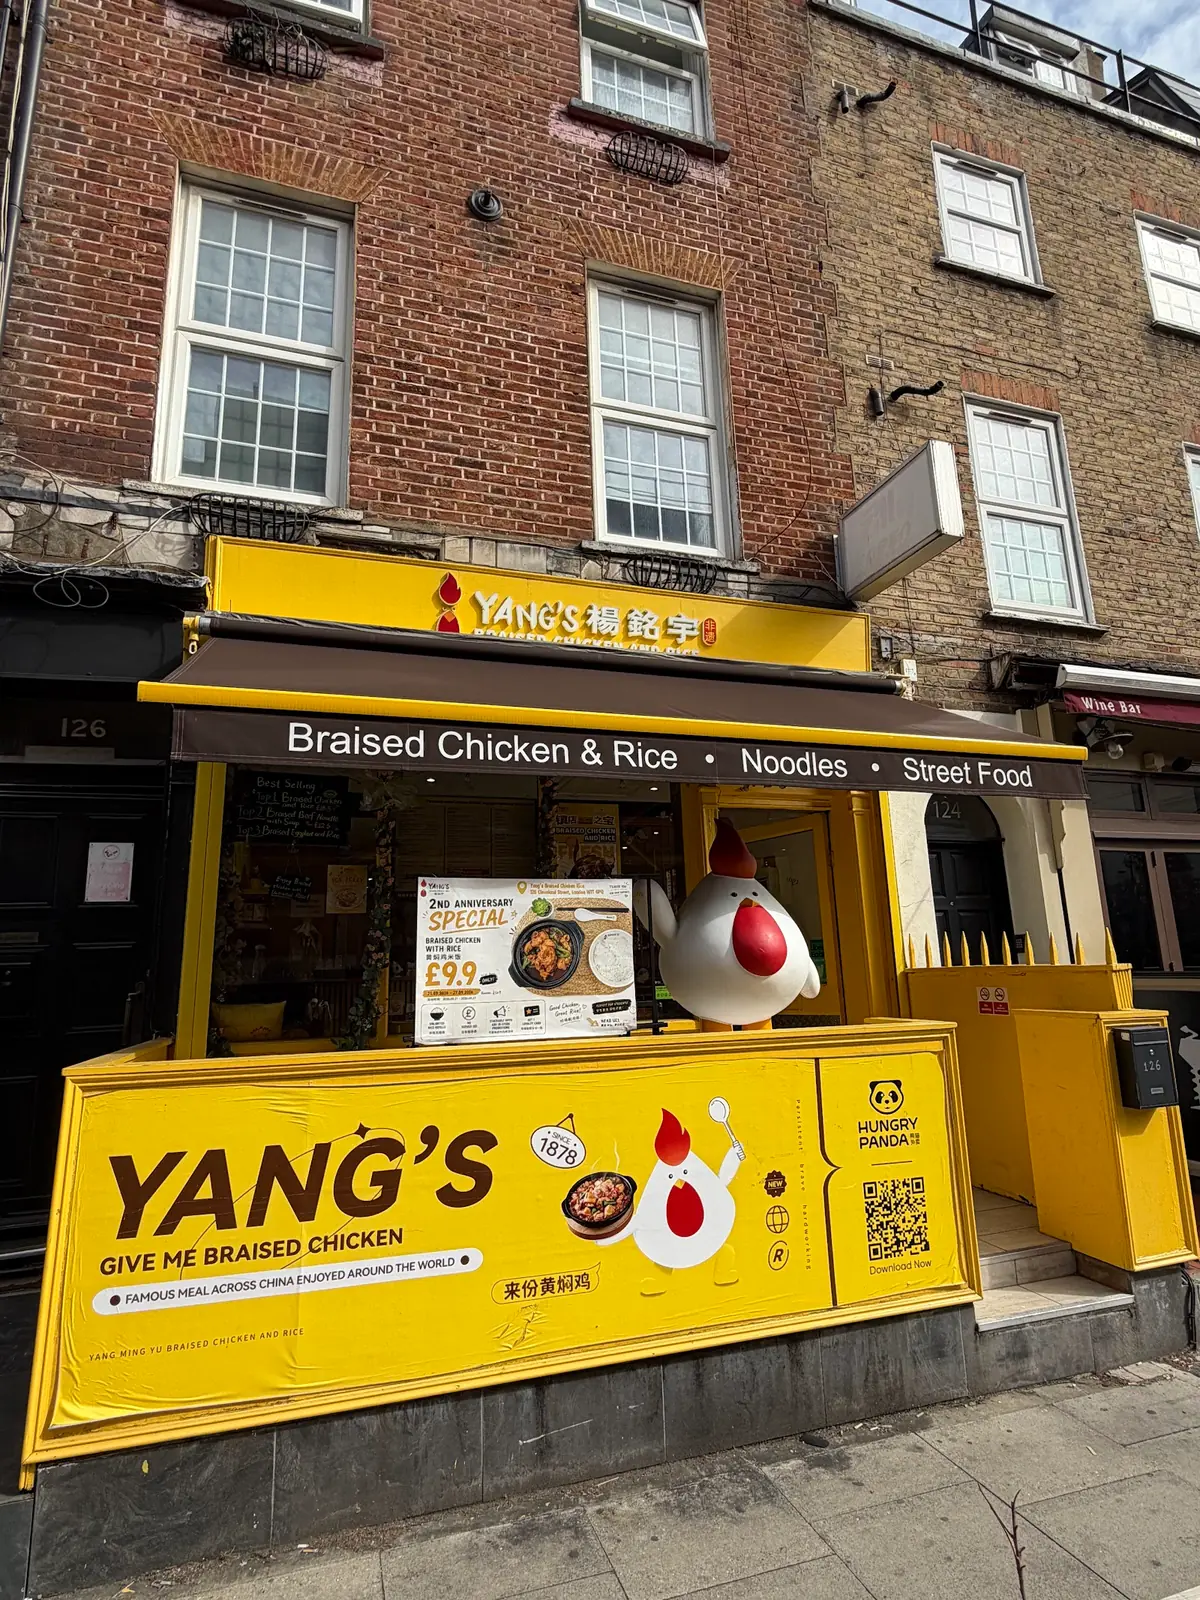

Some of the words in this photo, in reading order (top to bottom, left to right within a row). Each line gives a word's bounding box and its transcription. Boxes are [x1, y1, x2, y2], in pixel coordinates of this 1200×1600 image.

[474, 591, 579, 633] YANG'S
[586, 604, 701, 645] 楊銘宇
[1081, 697, 1115, 713] Wine
[1121, 700, 1142, 715] Bar
[61, 717, 106, 738] 126
[288, 722, 425, 758] Braised
[438, 731, 569, 764] Chicken
[580, 738, 603, 767] &
[614, 741, 678, 770] Rice
[741, 748, 848, 778] Noodles
[903, 757, 972, 785] Street
[978, 762, 1033, 788] Food
[257, 776, 280, 788] Best
[284, 778, 316, 795] Selling
[932, 801, 962, 819] 124
[429, 899, 450, 909] 2ND
[454, 898, 514, 908] ANNIVERSARY
[428, 908, 508, 931] SPECIAL
[425, 961, 477, 986] £9.9
[1143, 1059, 1161, 1072] 126
[858, 1117, 918, 1134] HUNGRY
[552, 1131, 572, 1145] SINCE
[859, 1133, 909, 1149] PANDA
[540, 1138, 578, 1165] 1878
[109, 1125, 499, 1240] YANG'S
[768, 1180, 783, 1188] NEW
[100, 1253, 156, 1276] GIVE
[163, 1249, 197, 1269] ME
[204, 1238, 301, 1265] BRAISED
[308, 1228, 403, 1254] CHICKEN
[869, 1263, 912, 1275] Download
[914, 1259, 932, 1268] Now
[125, 1289, 181, 1305] FAMOUS
[178, 1286, 210, 1299] MEAL
[211, 1280, 257, 1295] ACROSS
[259, 1276, 295, 1290] CHINA
[296, 1270, 346, 1285] ENJOYED
[347, 1264, 394, 1279] AROUND
[396, 1261, 416, 1273] THE
[418, 1257, 455, 1270] WORLD
[504, 1272, 591, 1300] 来份黄焖鸡
[89, 1351, 116, 1361] YANG
[120, 1348, 146, 1358] MING
[149, 1346, 162, 1354] YU
[167, 1340, 209, 1352] BRAISED
[213, 1333, 255, 1346] CHICKEN
[259, 1330, 279, 1340] AND
[283, 1328, 304, 1337] RICE
